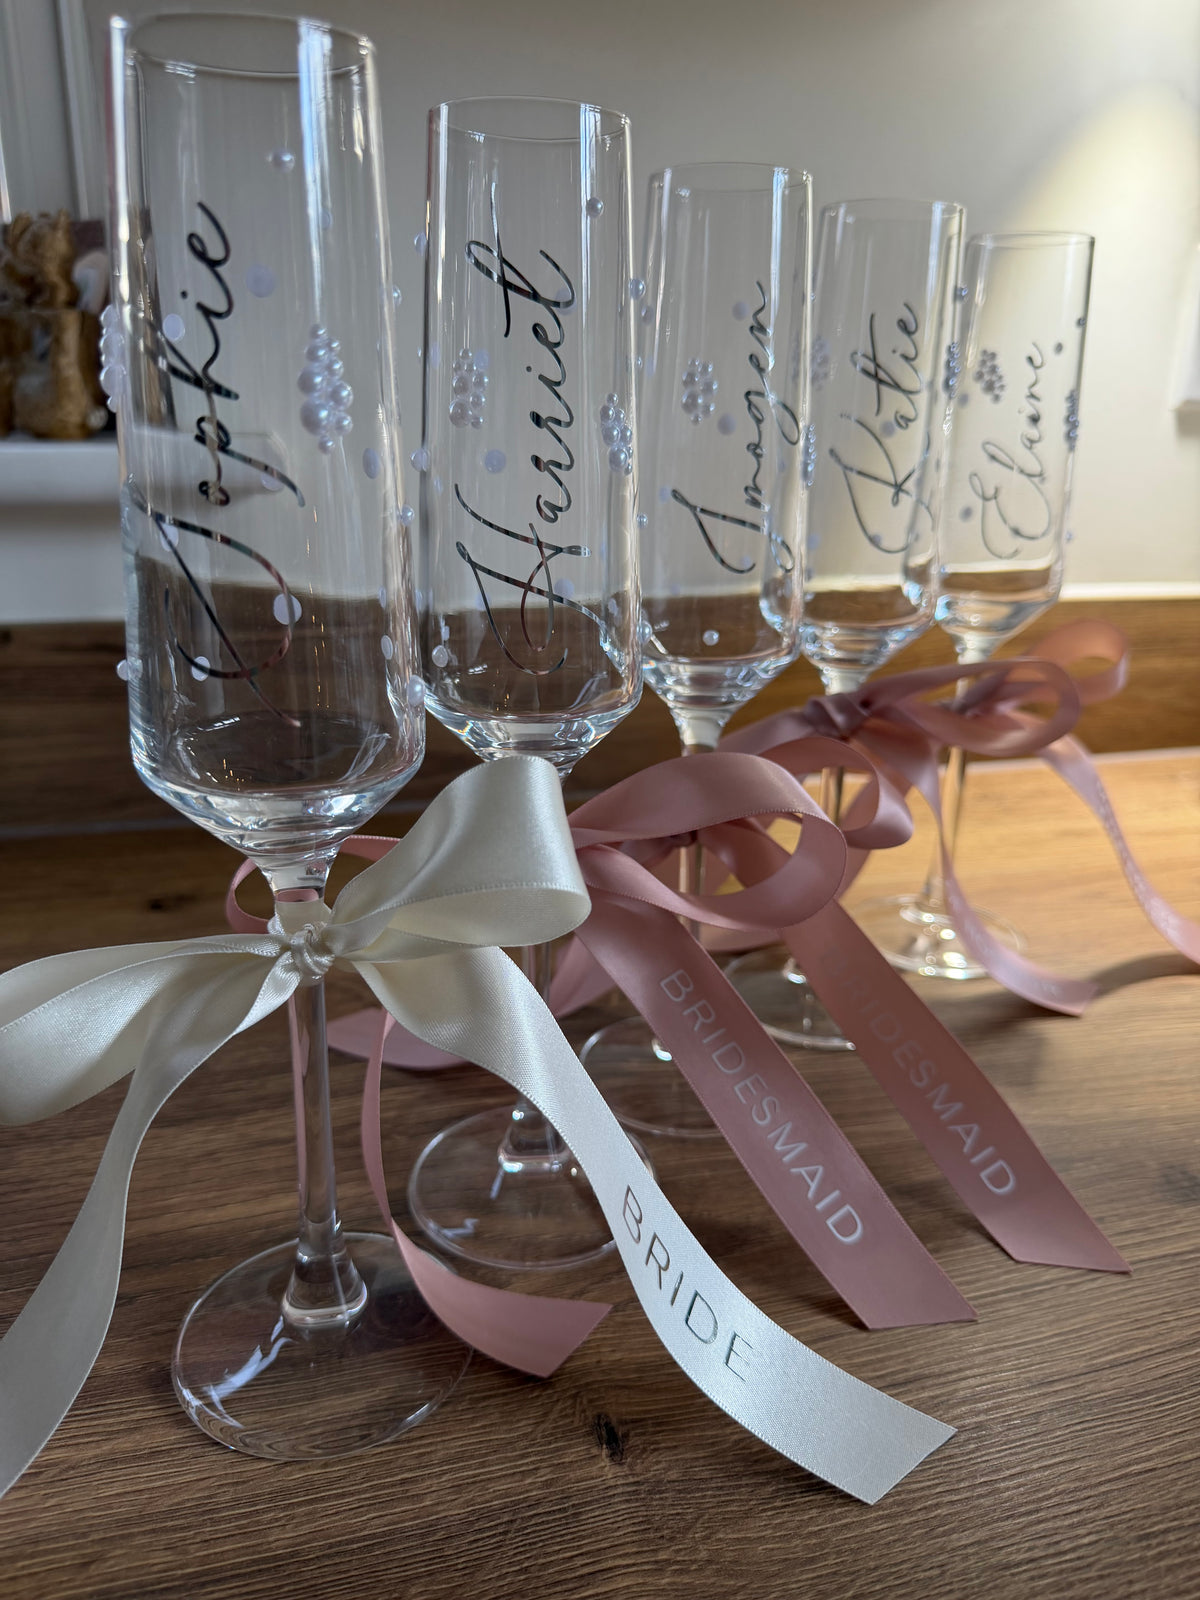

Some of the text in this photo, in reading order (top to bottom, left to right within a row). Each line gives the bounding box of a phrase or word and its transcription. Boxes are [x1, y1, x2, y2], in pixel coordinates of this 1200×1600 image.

[455, 182, 606, 675] Harriet
[671, 281, 799, 574] Imogen
[829, 303, 934, 554] Katie
[968, 343, 1051, 560] Elaine
[659, 967, 865, 1246] BRIDESMAID
[818, 948, 1017, 1197] BRIDESMAID
[621, 1184, 757, 1382] BRIDE
